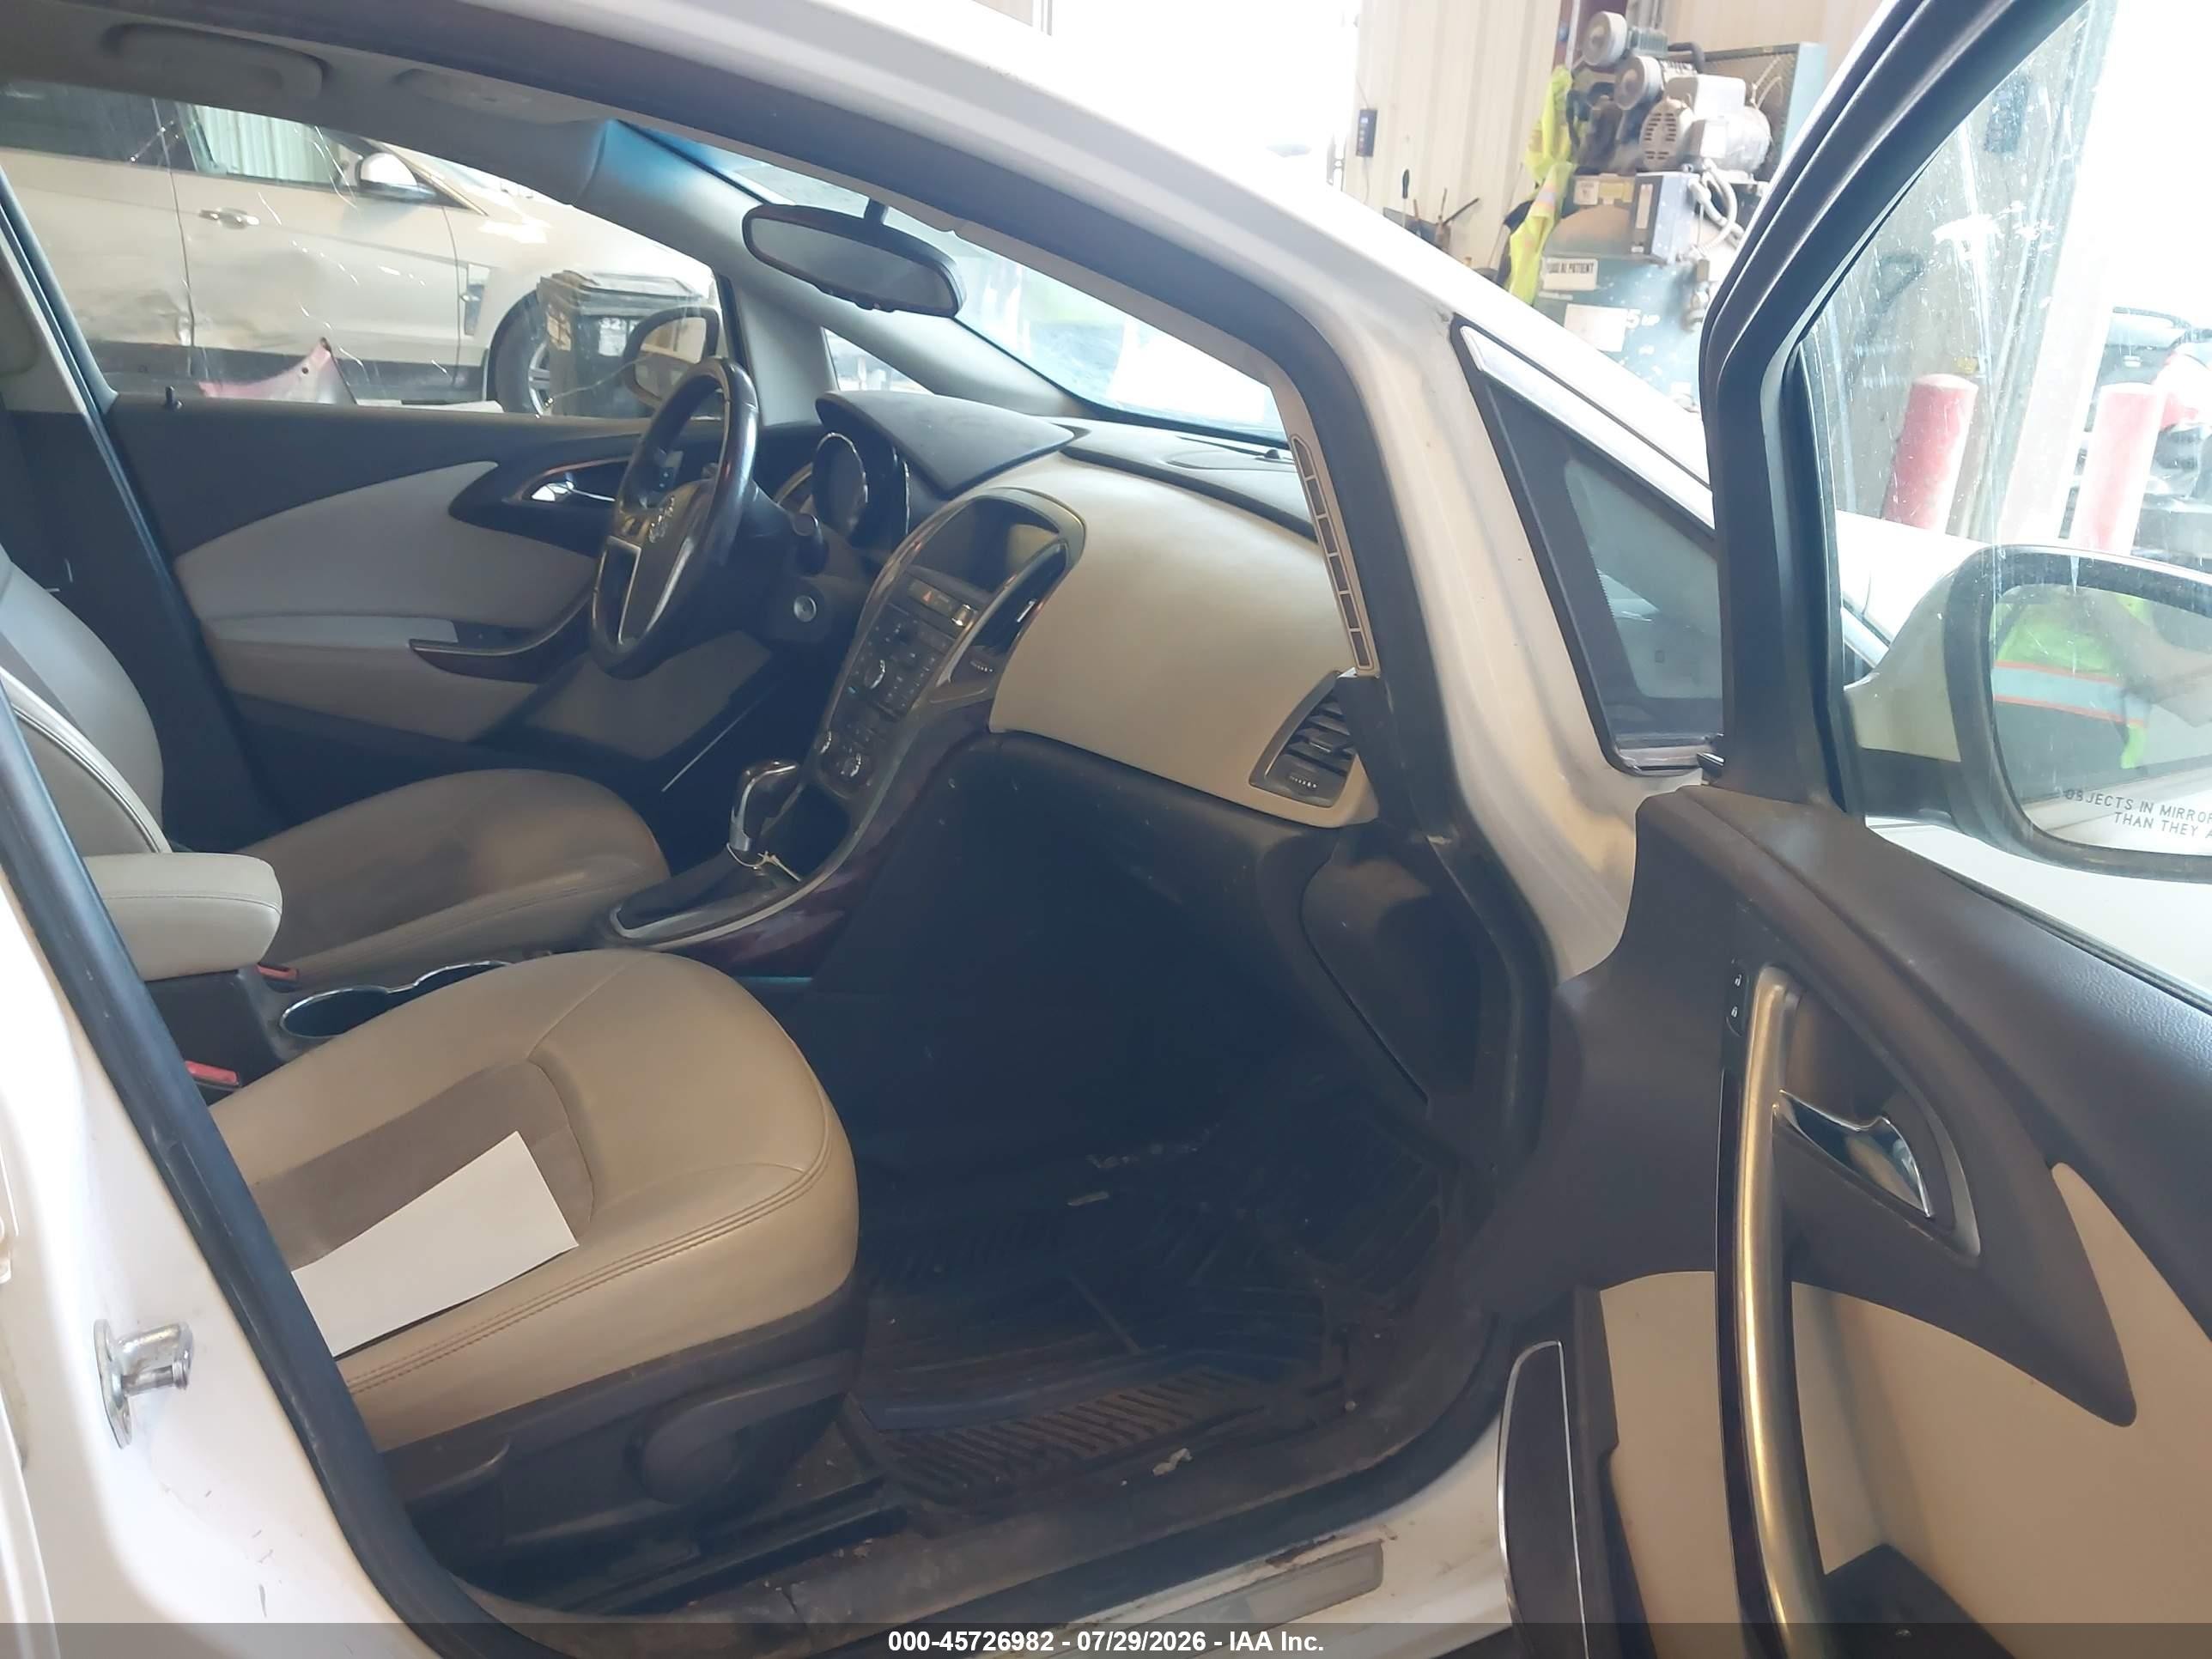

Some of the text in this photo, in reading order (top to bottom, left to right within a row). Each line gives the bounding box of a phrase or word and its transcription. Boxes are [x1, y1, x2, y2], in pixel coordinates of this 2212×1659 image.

[2064, 788, 2134, 811] OBJECTS
[2139, 800, 2154, 814] IN
[2114, 811, 2154, 830] THAN
[2161, 820, 2198, 837] THEY
